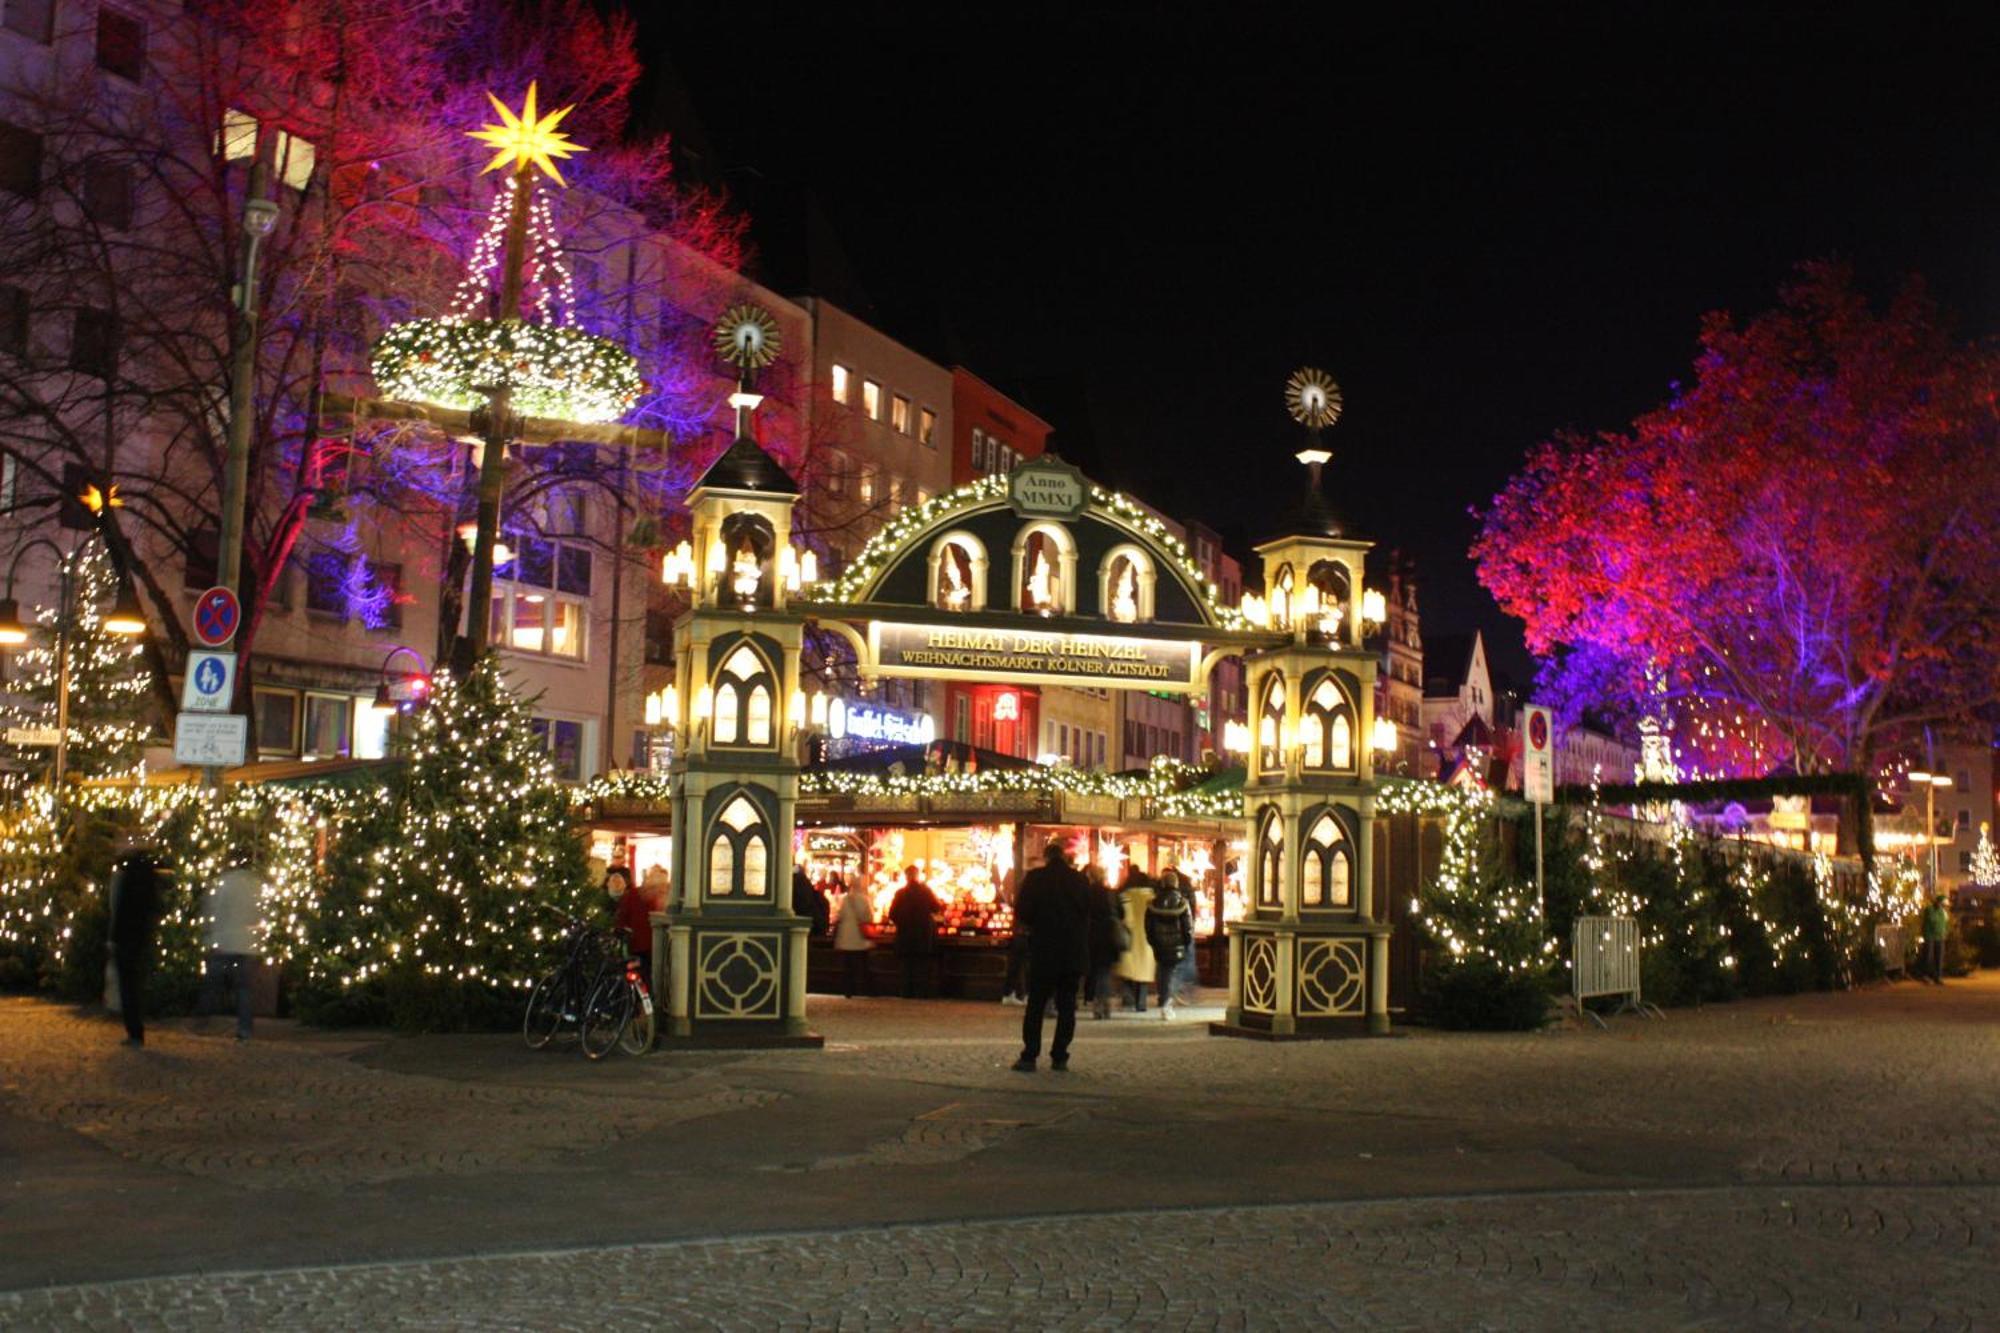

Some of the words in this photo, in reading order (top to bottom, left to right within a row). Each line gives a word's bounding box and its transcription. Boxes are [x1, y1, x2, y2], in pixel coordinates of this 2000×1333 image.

[1025, 474, 1066, 489] Anno
[1022, 490, 1073, 507] MMXI
[928, 632, 1010, 652] HEIMAT
[1013, 638, 1055, 656] DER
[1060, 641, 1147, 661] HEINZEL
[902, 651, 1043, 671] WEIHNACHTSMARKT
[1047, 656, 1105, 675] KÖLNER
[1107, 663, 1170, 679] ALTSTADT
